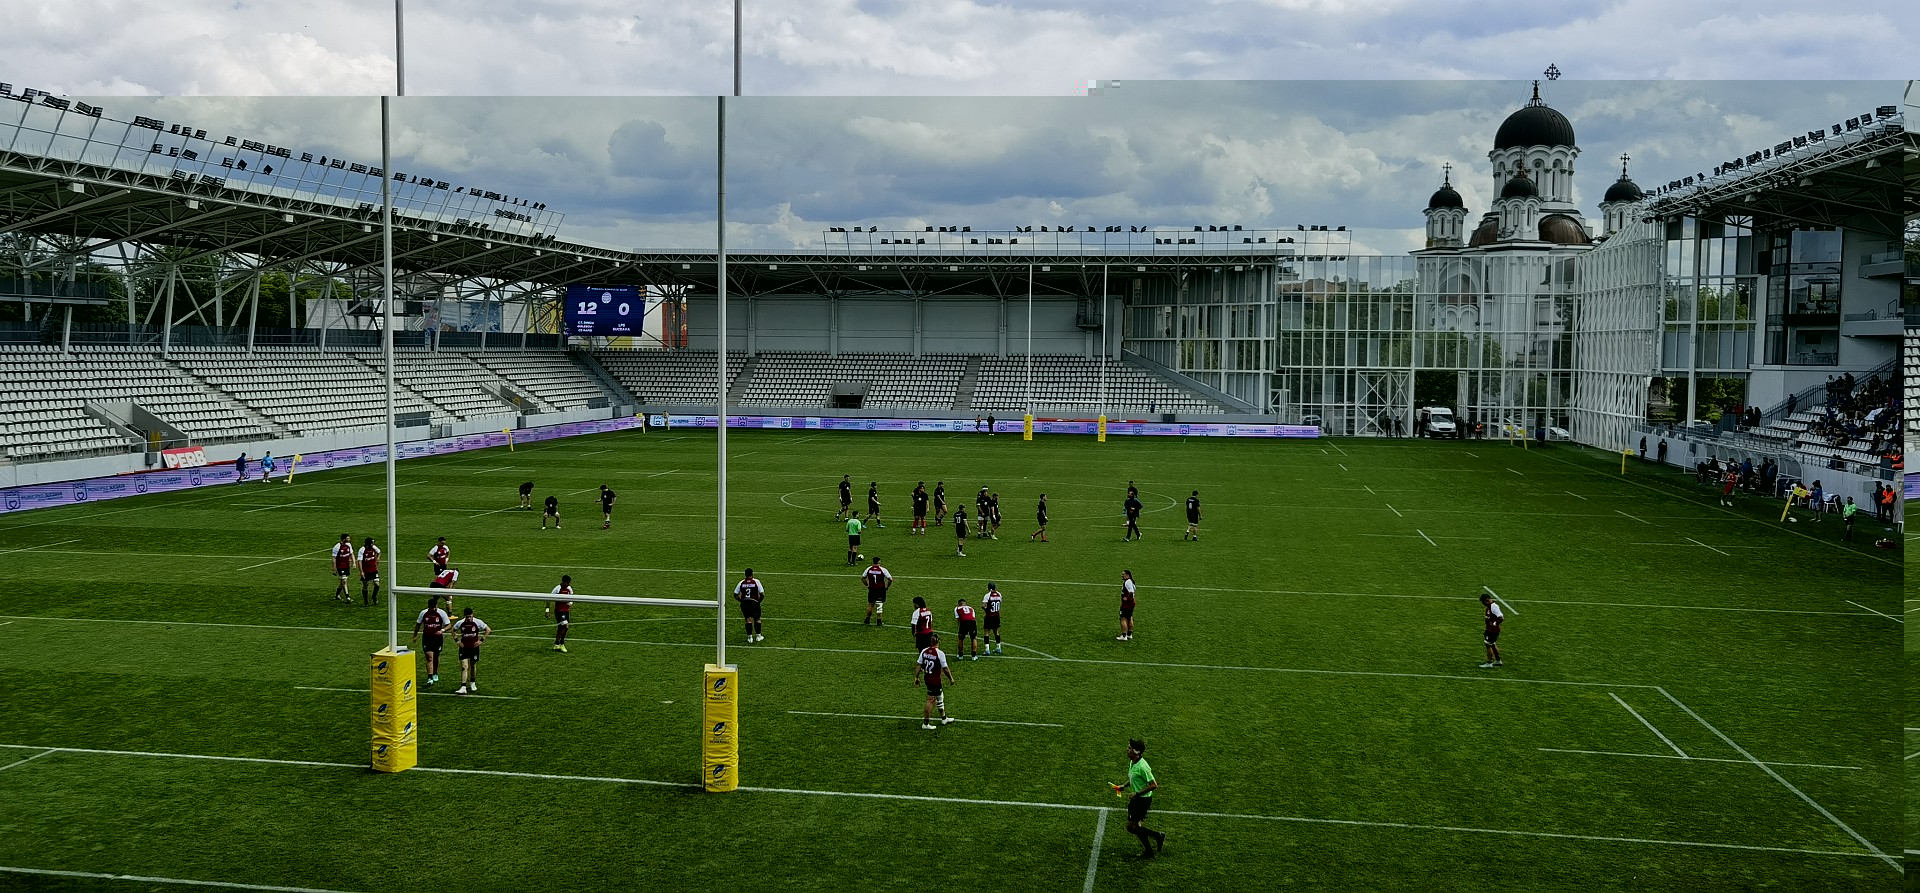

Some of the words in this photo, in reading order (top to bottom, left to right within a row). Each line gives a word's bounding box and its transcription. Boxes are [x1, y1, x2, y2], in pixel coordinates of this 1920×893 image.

[578, 302, 597, 314] 12
[619, 303, 629, 315] 0
[166, 451, 207, 468] PERB
[872, 574, 878, 585] 1
[990, 601, 1001, 613] 30
[925, 615, 931, 629] 7
[923, 659, 935, 674] 22
